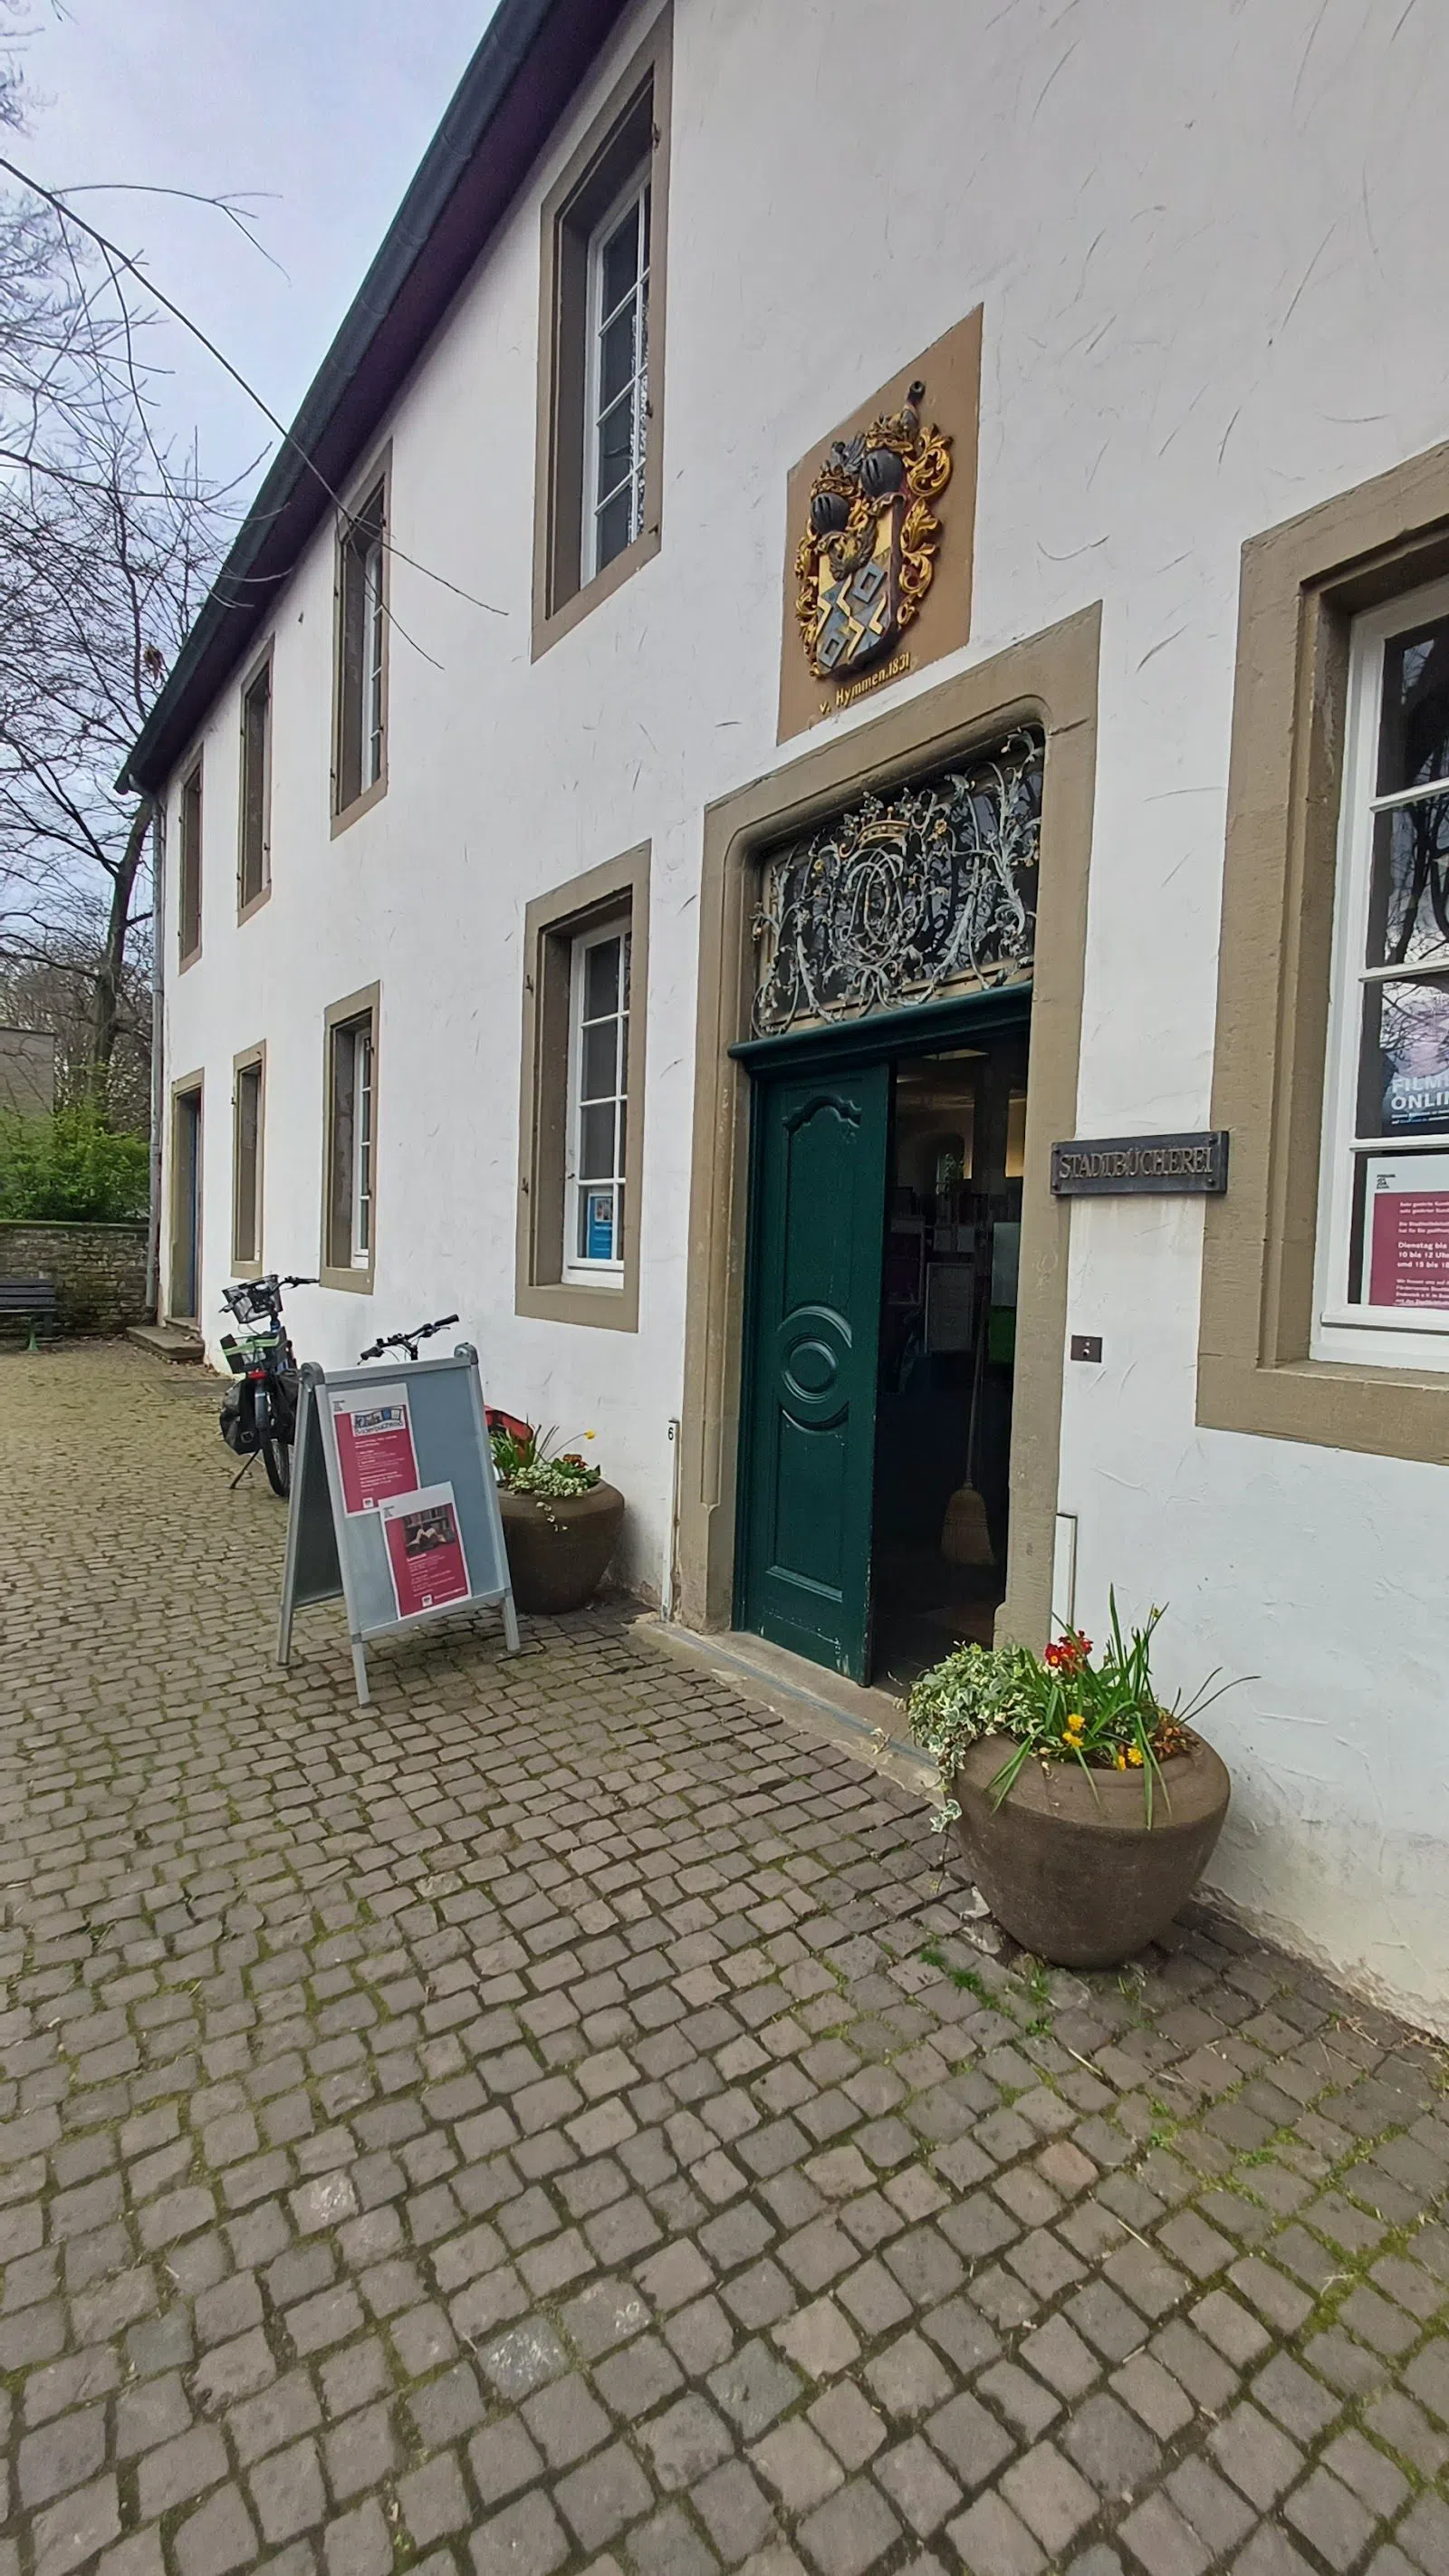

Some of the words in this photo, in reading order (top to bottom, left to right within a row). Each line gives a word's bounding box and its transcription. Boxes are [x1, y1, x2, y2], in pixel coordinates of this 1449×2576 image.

[820, 701, 831, 715] v.
[1059, 1147, 1213, 1178] STADTBÜCHEREI
[1397, 1241, 1433, 1250] Dienstag
[1435, 1241, 1447, 1249] bis
[667, 1427, 674, 1441] 6
